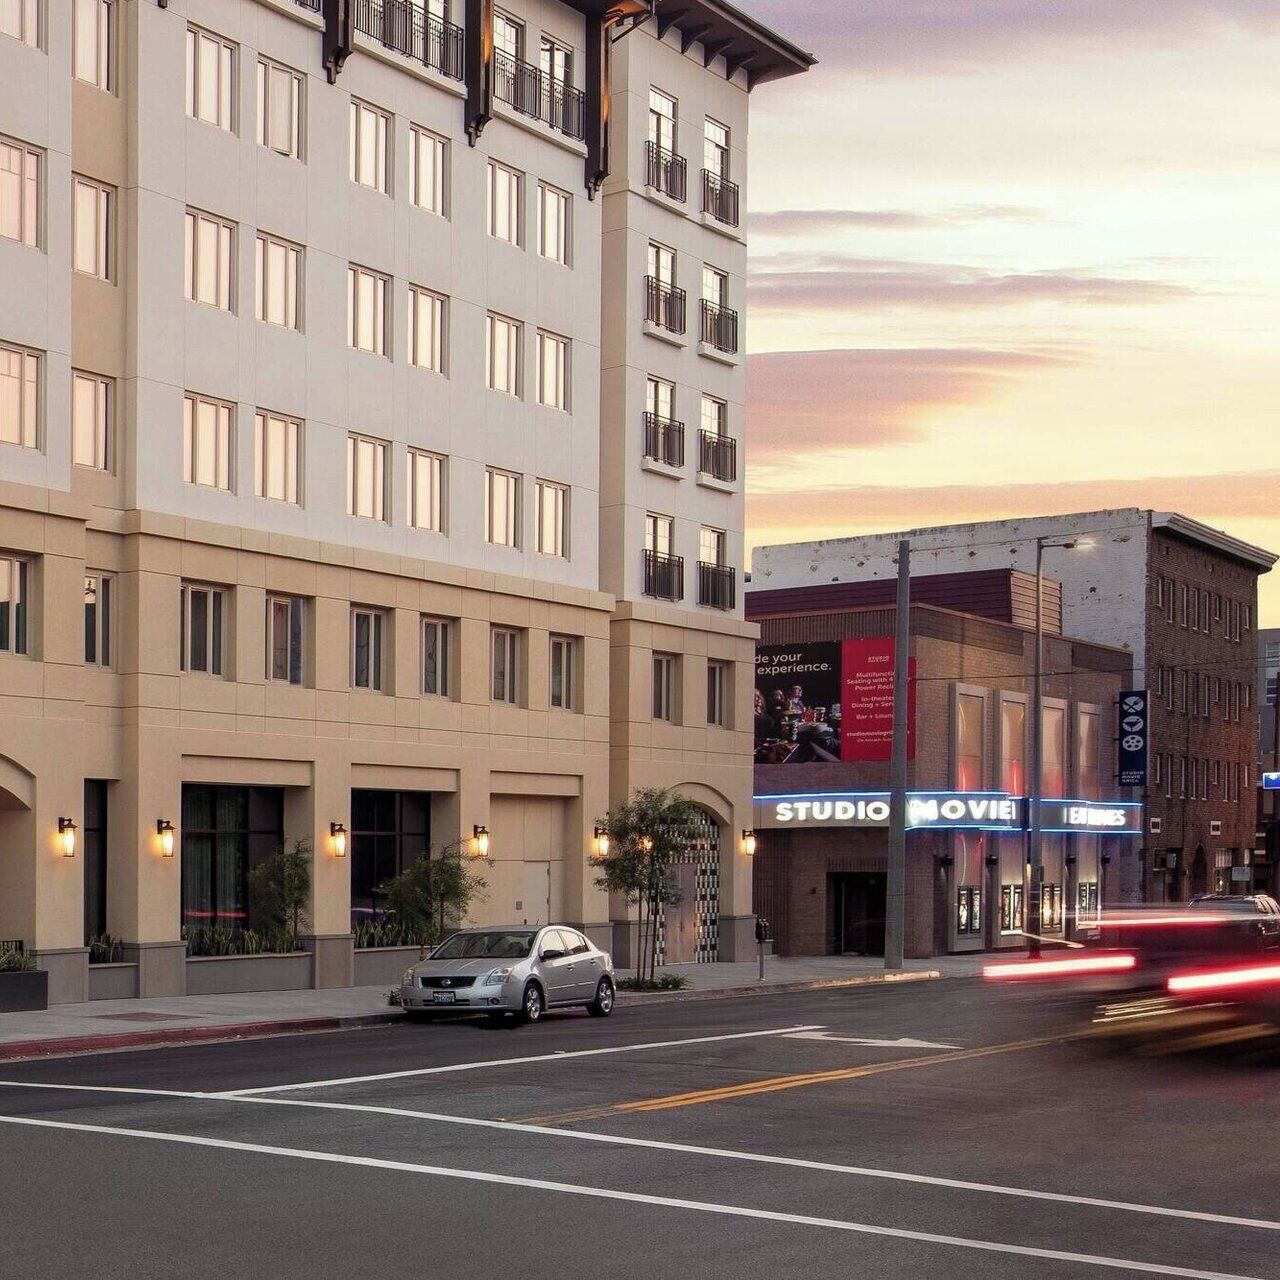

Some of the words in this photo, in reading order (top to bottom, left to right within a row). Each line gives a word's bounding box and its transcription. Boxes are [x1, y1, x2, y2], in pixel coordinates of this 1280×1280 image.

[772, 653, 802, 665] your
[757, 663, 832, 676] experience.
[775, 800, 890, 821] STUDIO
[909, 799, 1012, 821] MOVIE
